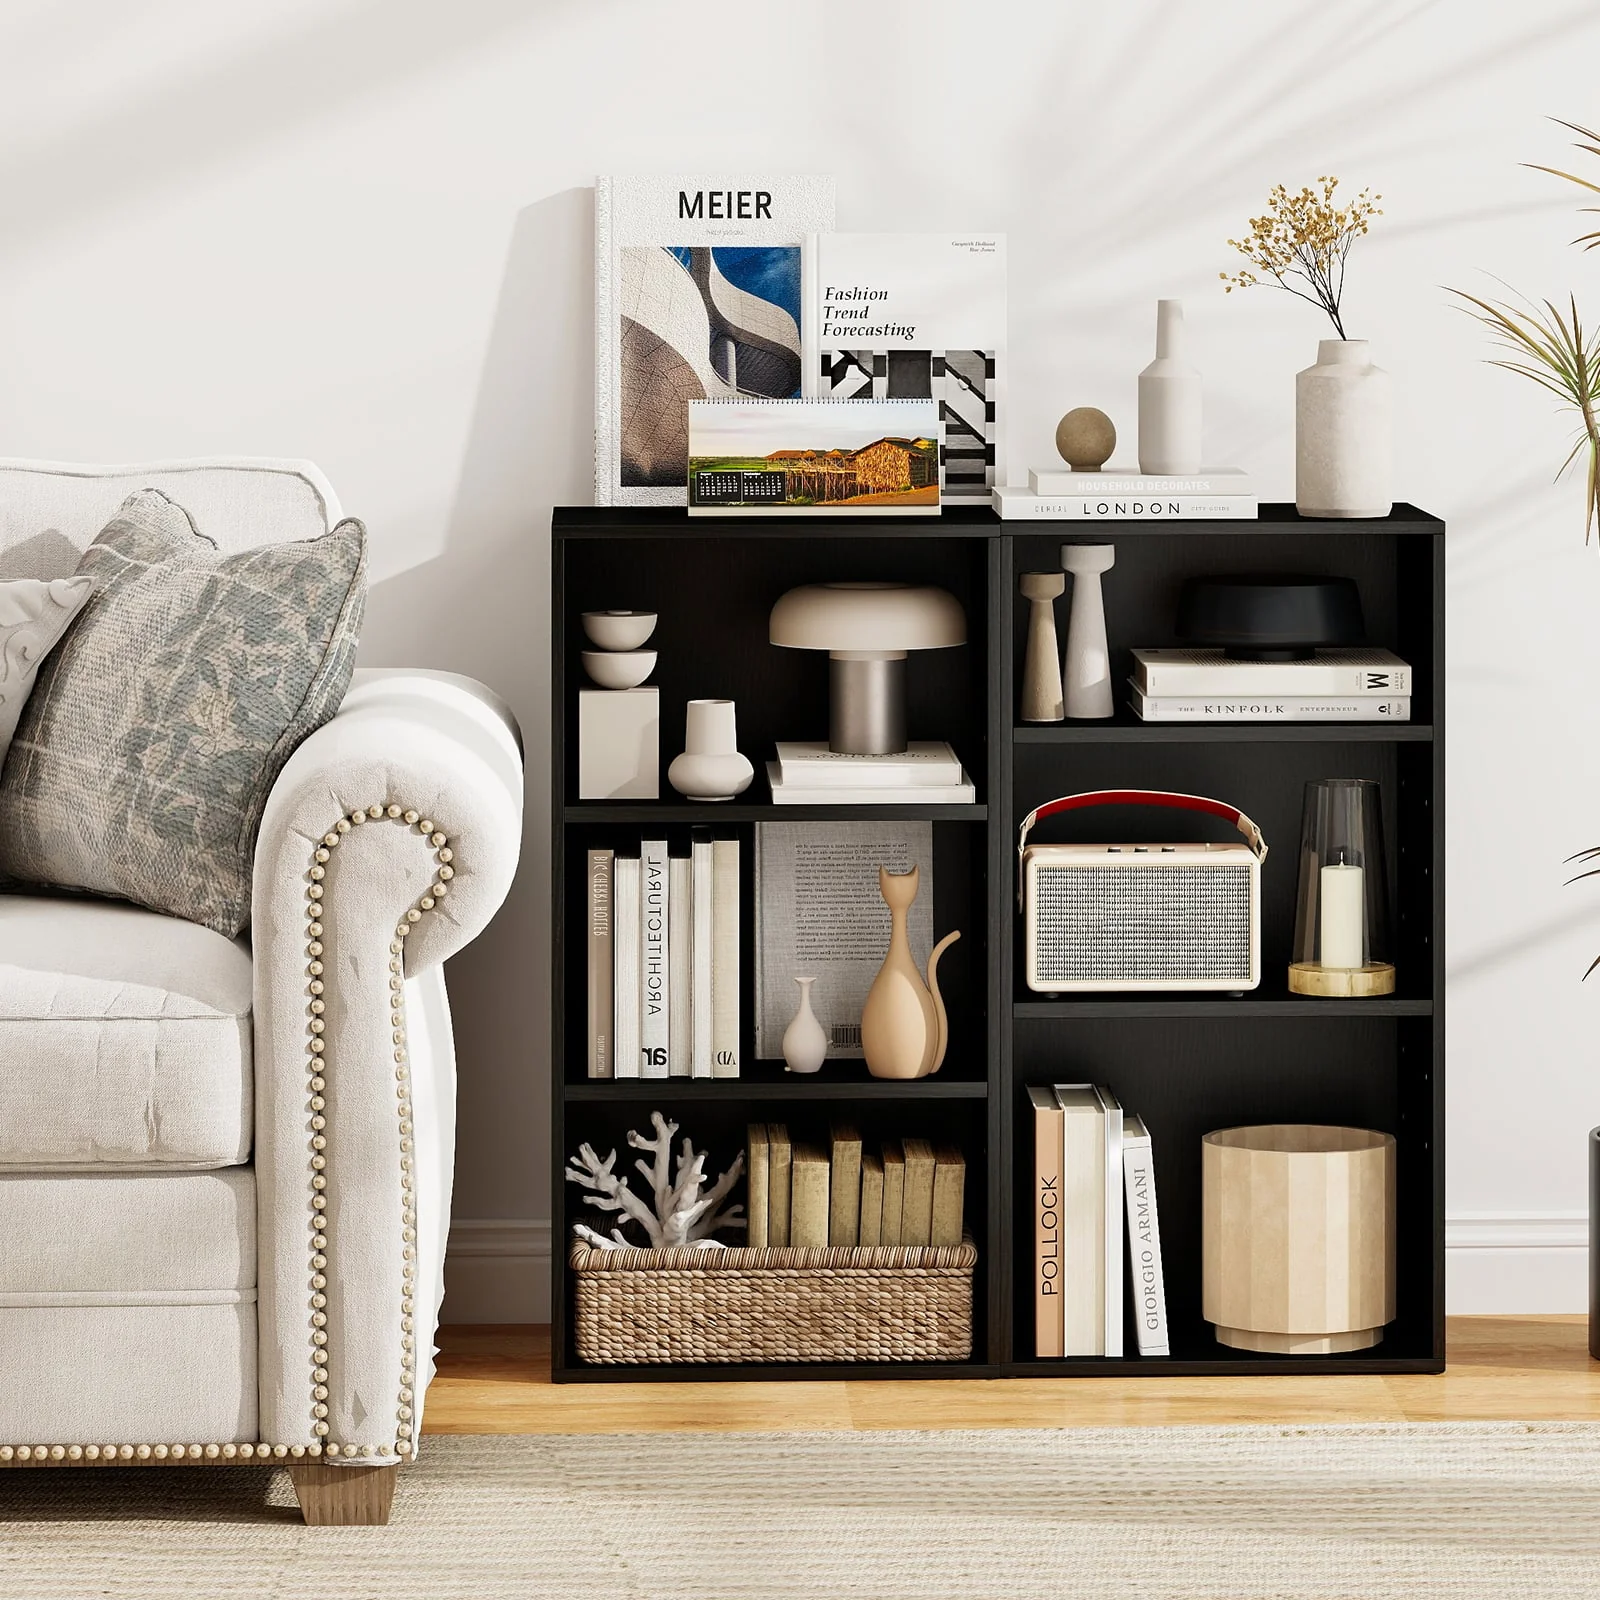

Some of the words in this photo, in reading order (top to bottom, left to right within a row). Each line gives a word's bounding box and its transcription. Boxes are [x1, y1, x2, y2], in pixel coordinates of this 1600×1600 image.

[678, 191, 772, 219] MEIER
[824, 286, 889, 301] Fashion
[823, 305, 870, 320] Trend
[822, 322, 917, 341] Forecasting
[1077, 481, 1145, 491] HOUSEHOLD
[1147, 481, 1211, 491] DECORATES
[1034, 505, 1068, 513] CEREAL
[1083, 502, 1181, 515] LONDON
[1204, 704, 1285, 714] KINFOLK
[1133, 1167, 1152, 1243] ARMANI
[1041, 1175, 1059, 1296] POLLOCK
[1141, 1250, 1159, 1330] GIORGIO
